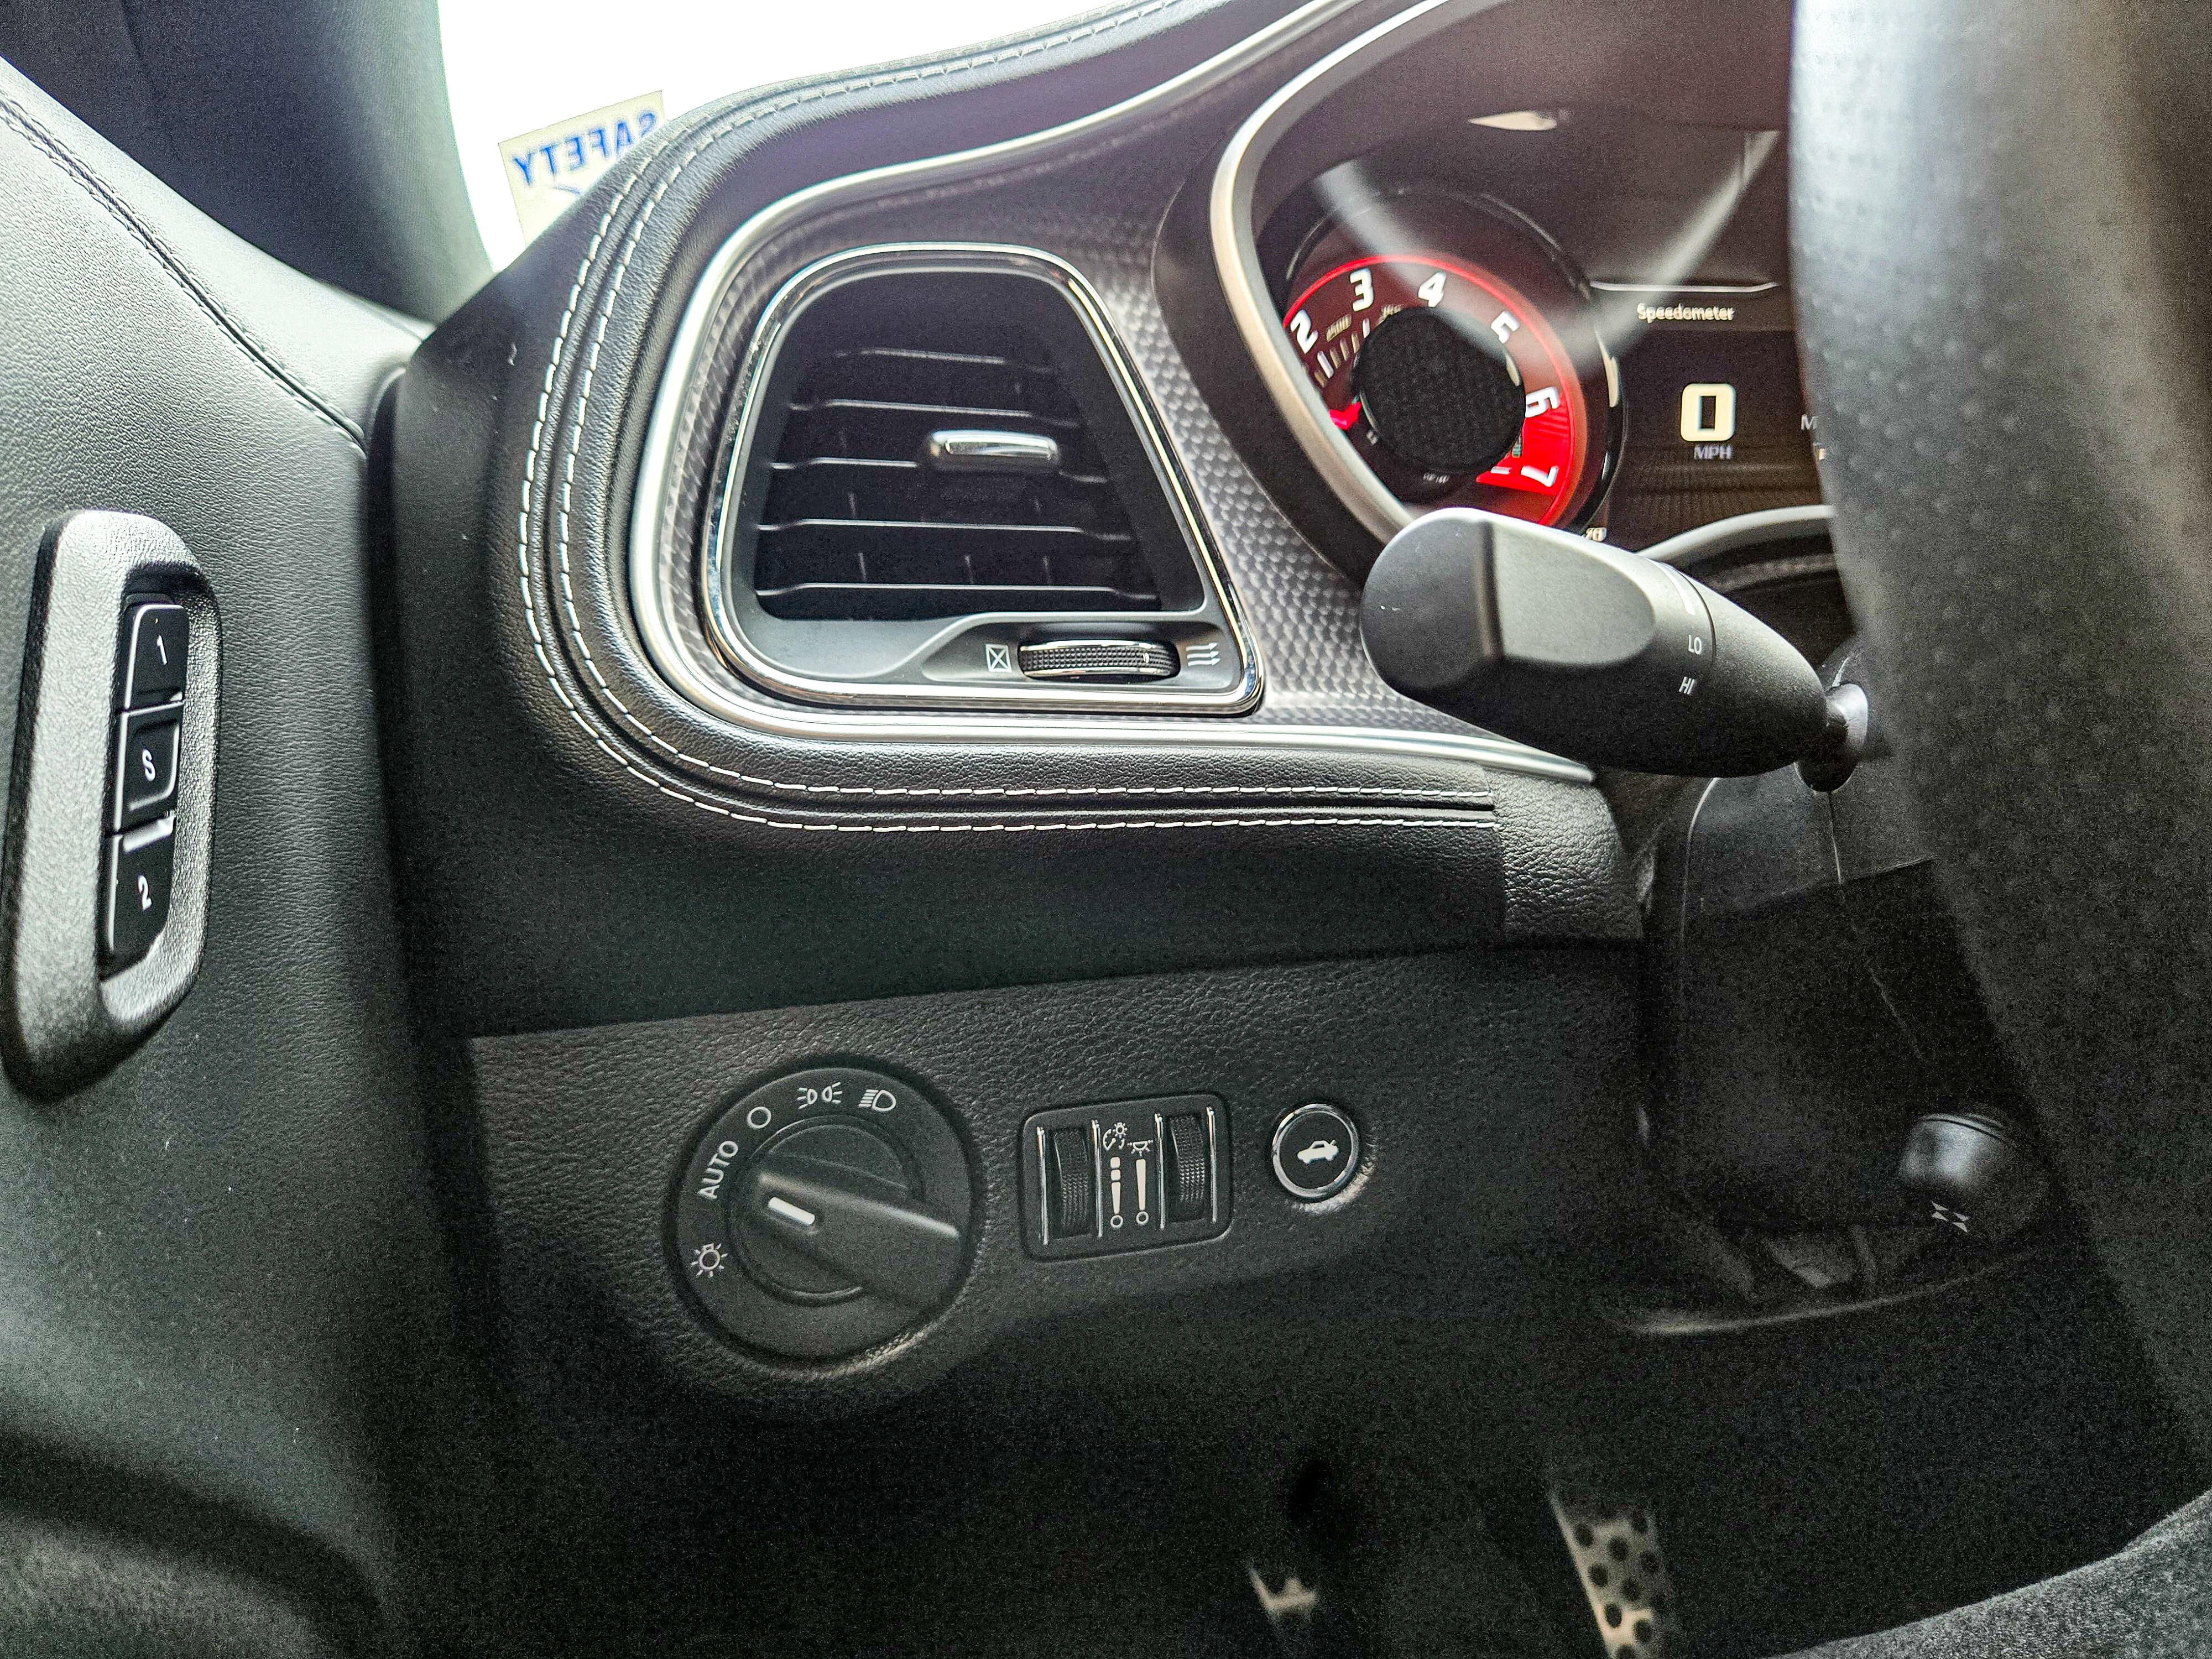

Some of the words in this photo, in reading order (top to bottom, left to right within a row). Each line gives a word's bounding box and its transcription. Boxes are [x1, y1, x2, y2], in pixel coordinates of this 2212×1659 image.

[1350, 268, 1374, 311] 3
[1417, 272, 1447, 307] 4
[1491, 311, 1520, 343] 5
[1637, 302, 1735, 324] Speedometer
[1290, 310, 1318, 354] 2
[1525, 387, 1559, 418] 6
[1681, 383, 1736, 442] 0
[1694, 445, 1734, 461] MPH
[1520, 465, 1559, 487] 7
[156, 634, 168, 665] 1
[1688, 634, 1702, 655] LO
[1678, 676, 1695, 695] HI
[142, 748, 156, 781] S
[138, 875, 153, 911] 2
[697, 1140, 739, 1200] AUTO
